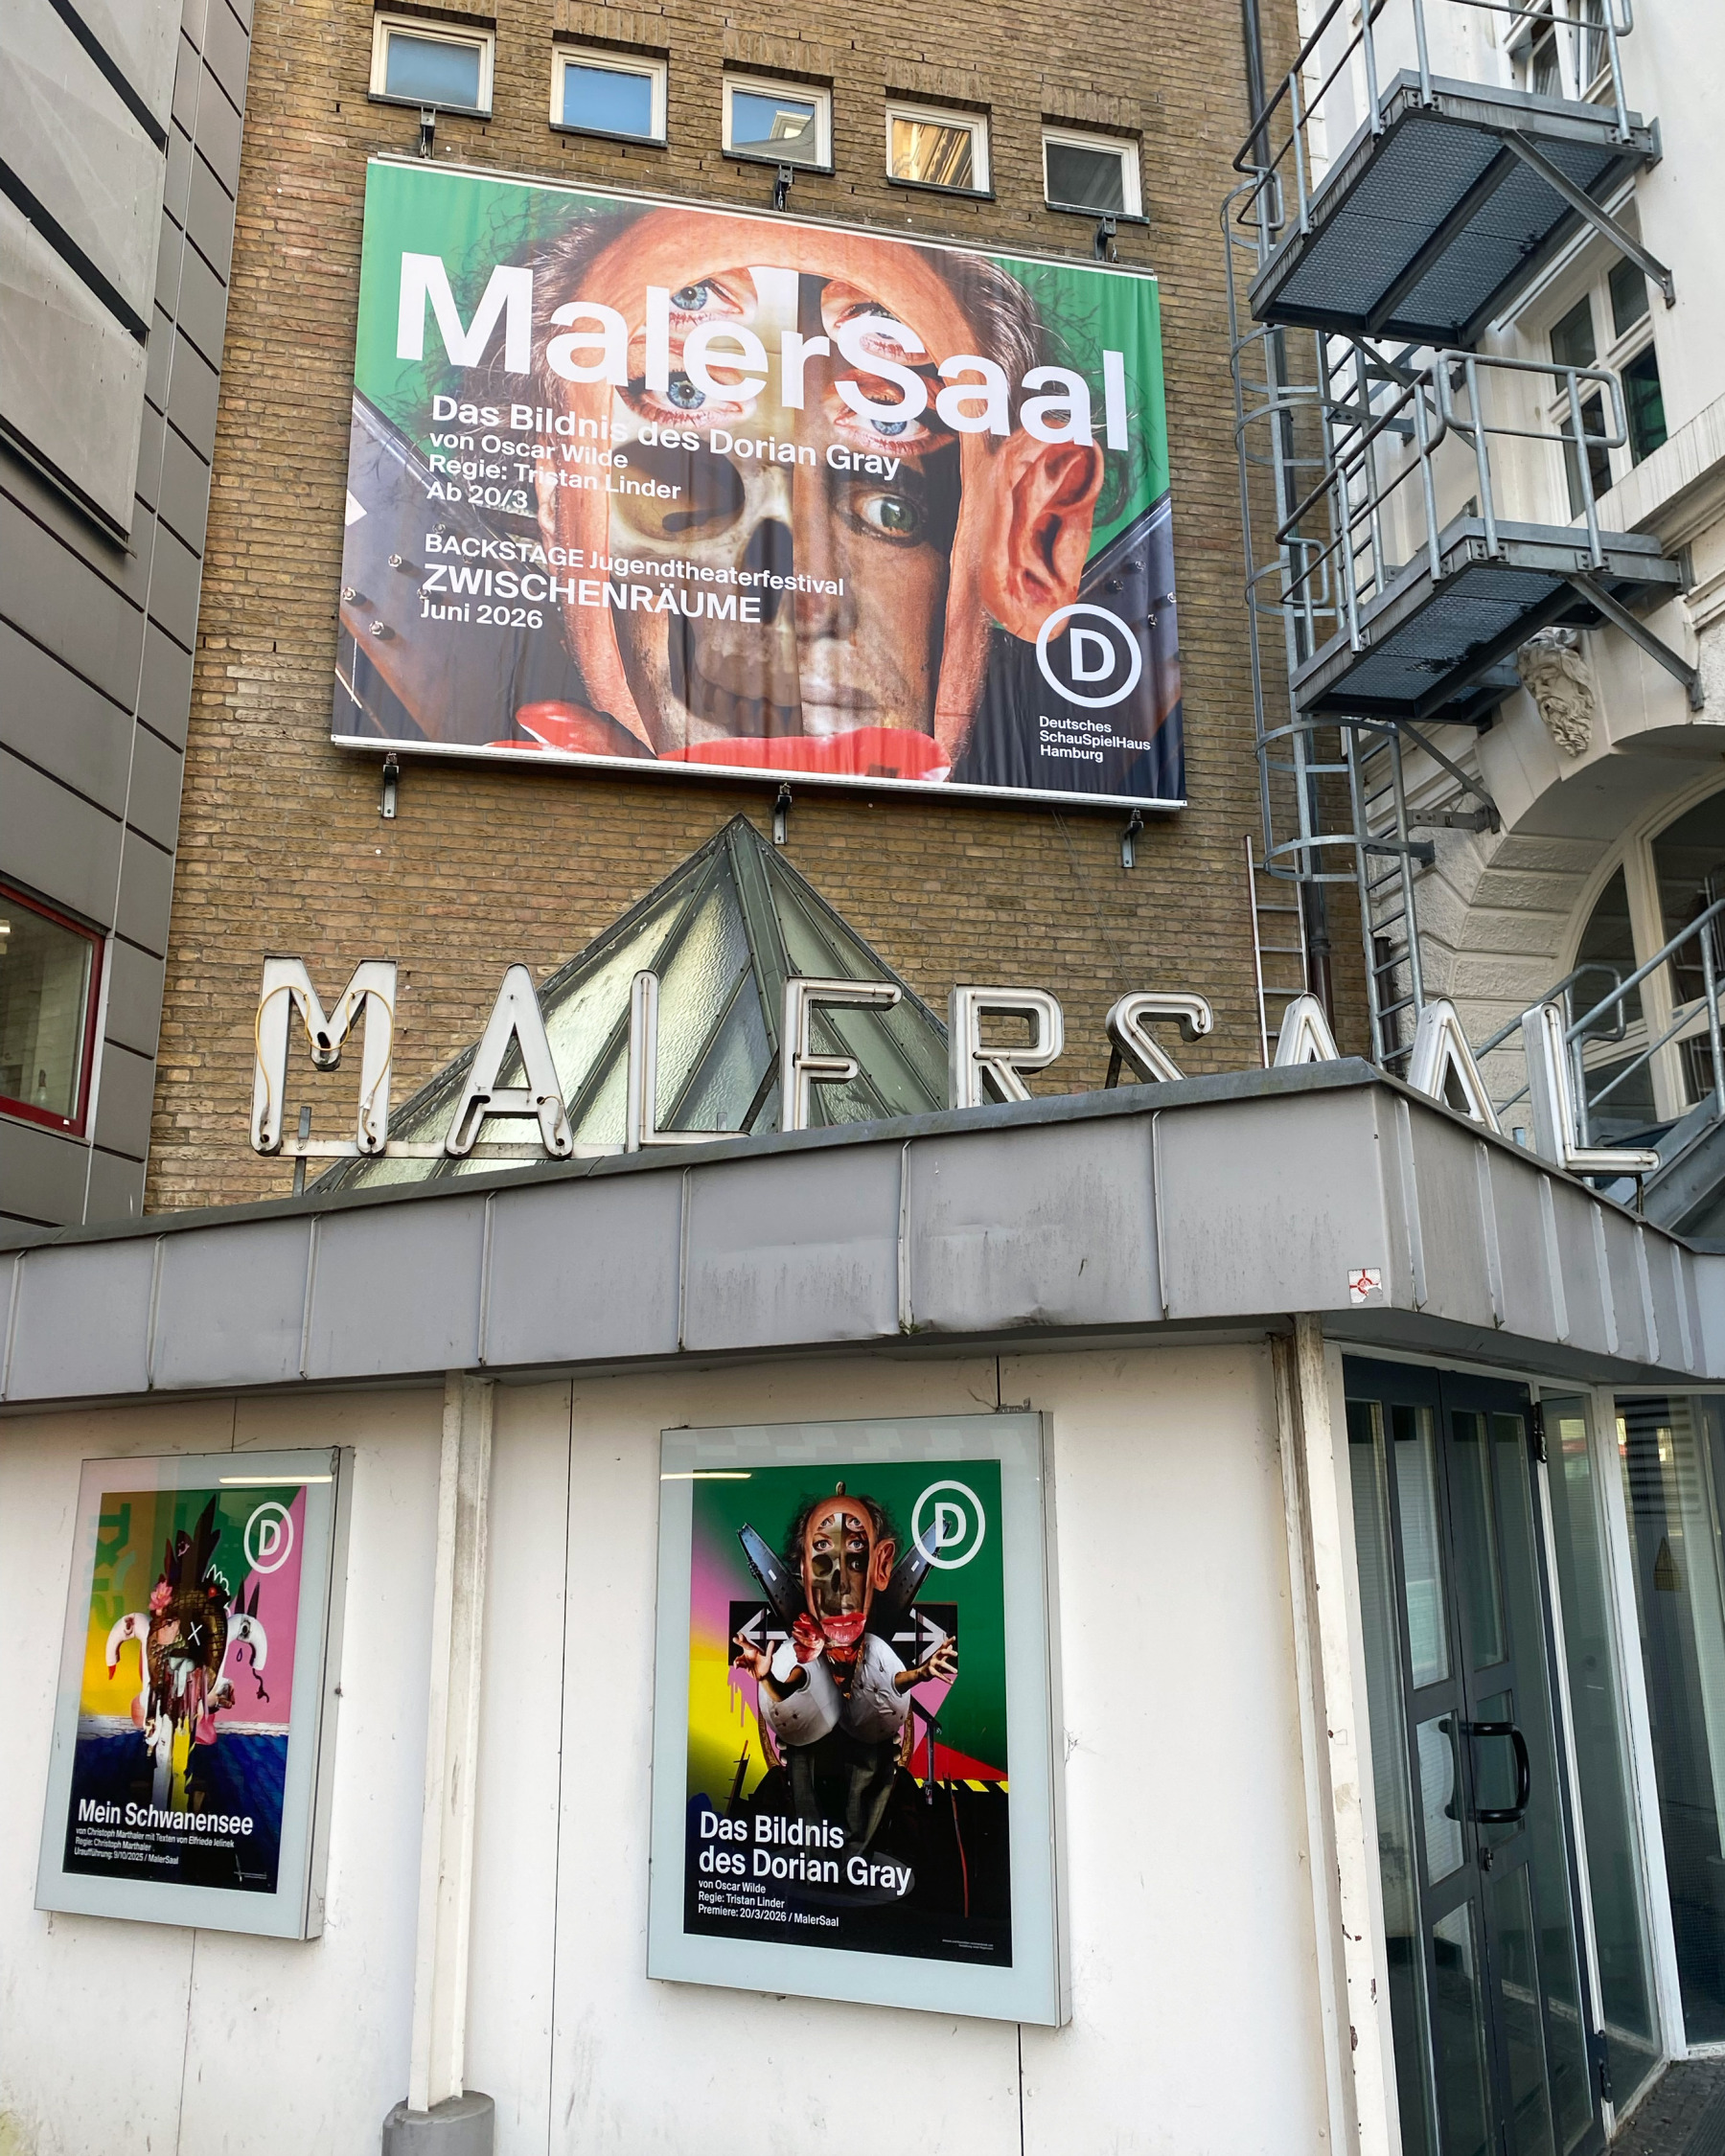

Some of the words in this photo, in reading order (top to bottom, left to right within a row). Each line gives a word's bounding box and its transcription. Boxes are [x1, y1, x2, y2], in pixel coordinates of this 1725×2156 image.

[395, 251, 1130, 451] MalerSaal
[430, 433, 474, 451] von
[481, 438, 555, 461] Oscar
[562, 447, 629, 469] Wilde
[432, 395, 499, 427] Das
[510, 403, 629, 442] Bildnis
[637, 421, 700, 451] des
[709, 429, 816, 466] Dorian
[825, 445, 900, 480] Gray
[429, 454, 507, 480] Regie:
[517, 463, 598, 491] Tristan
[606, 471, 681, 499] Linder
[426, 482, 463, 503] Ab
[468, 486, 528, 510] 20/3
[426, 533, 584, 569] BACKSTAGE
[589, 551, 844, 596] Jugendtheaterfestival
[422, 563, 761, 624] ZWISCHENRÄUME
[421, 599, 470, 622] Juni
[476, 606, 543, 630] 2026
[1039, 716, 1112, 732] Deutsches
[1039, 730, 1151, 750] SchauSpielHaus
[1040, 745, 1104, 763] Hamburg
[78, 1799, 121, 1824] Mein
[125, 1802, 254, 1835] Schwanensee
[701, 1811, 748, 1841] Das
[755, 1814, 844, 1848] Bildnis
[699, 1880, 713, 1889] von
[715, 1880, 740, 1892] Oscar
[742, 1882, 767, 1893] Wilde
[700, 1846, 746, 1875] des
[753, 1849, 839, 1884] Dorian
[847, 1856, 911, 1895] Gray
[699, 1892, 724, 1904] Regie:
[726, 1893, 755, 1906] Tristan
[757, 1896, 785, 1908] Linder
[699, 1904, 739, 1916] Premiere:
[740, 1908, 787, 1922] 20/3/2026
[794, 1914, 839, 1927] MalerSaal
